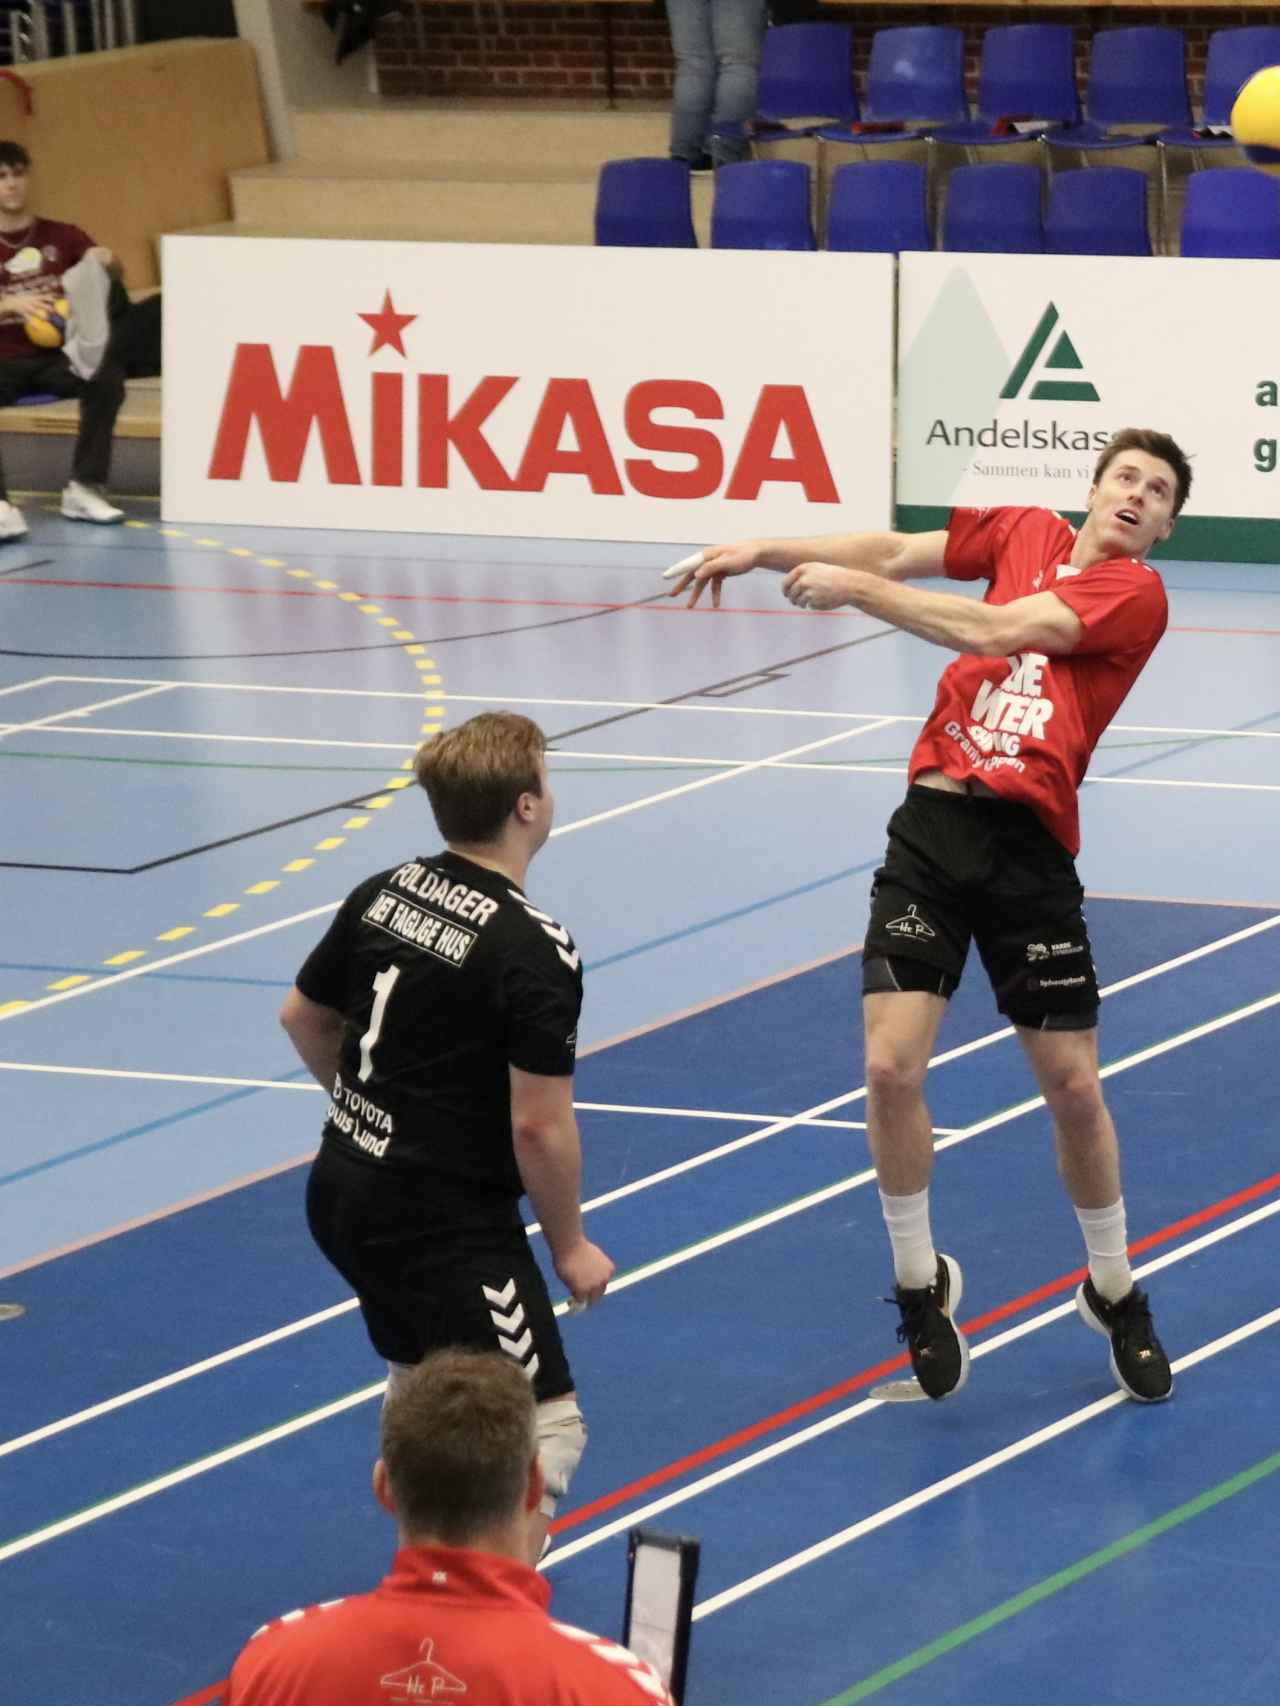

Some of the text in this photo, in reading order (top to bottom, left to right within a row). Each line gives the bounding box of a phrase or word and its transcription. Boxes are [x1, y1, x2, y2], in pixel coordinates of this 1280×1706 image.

[925, 418, 1112, 452] Andelskas
[972, 462, 1039, 479] Sammen
[1043, 463, 1072, 480] kan
[1073, 464, 1089, 480] vi
[434, 925, 471, 961] HUS
[357, 964, 400, 1083] 1
[327, 1102, 390, 1158] ouis Lund
[343, 1087, 393, 1133] TOYOTA
